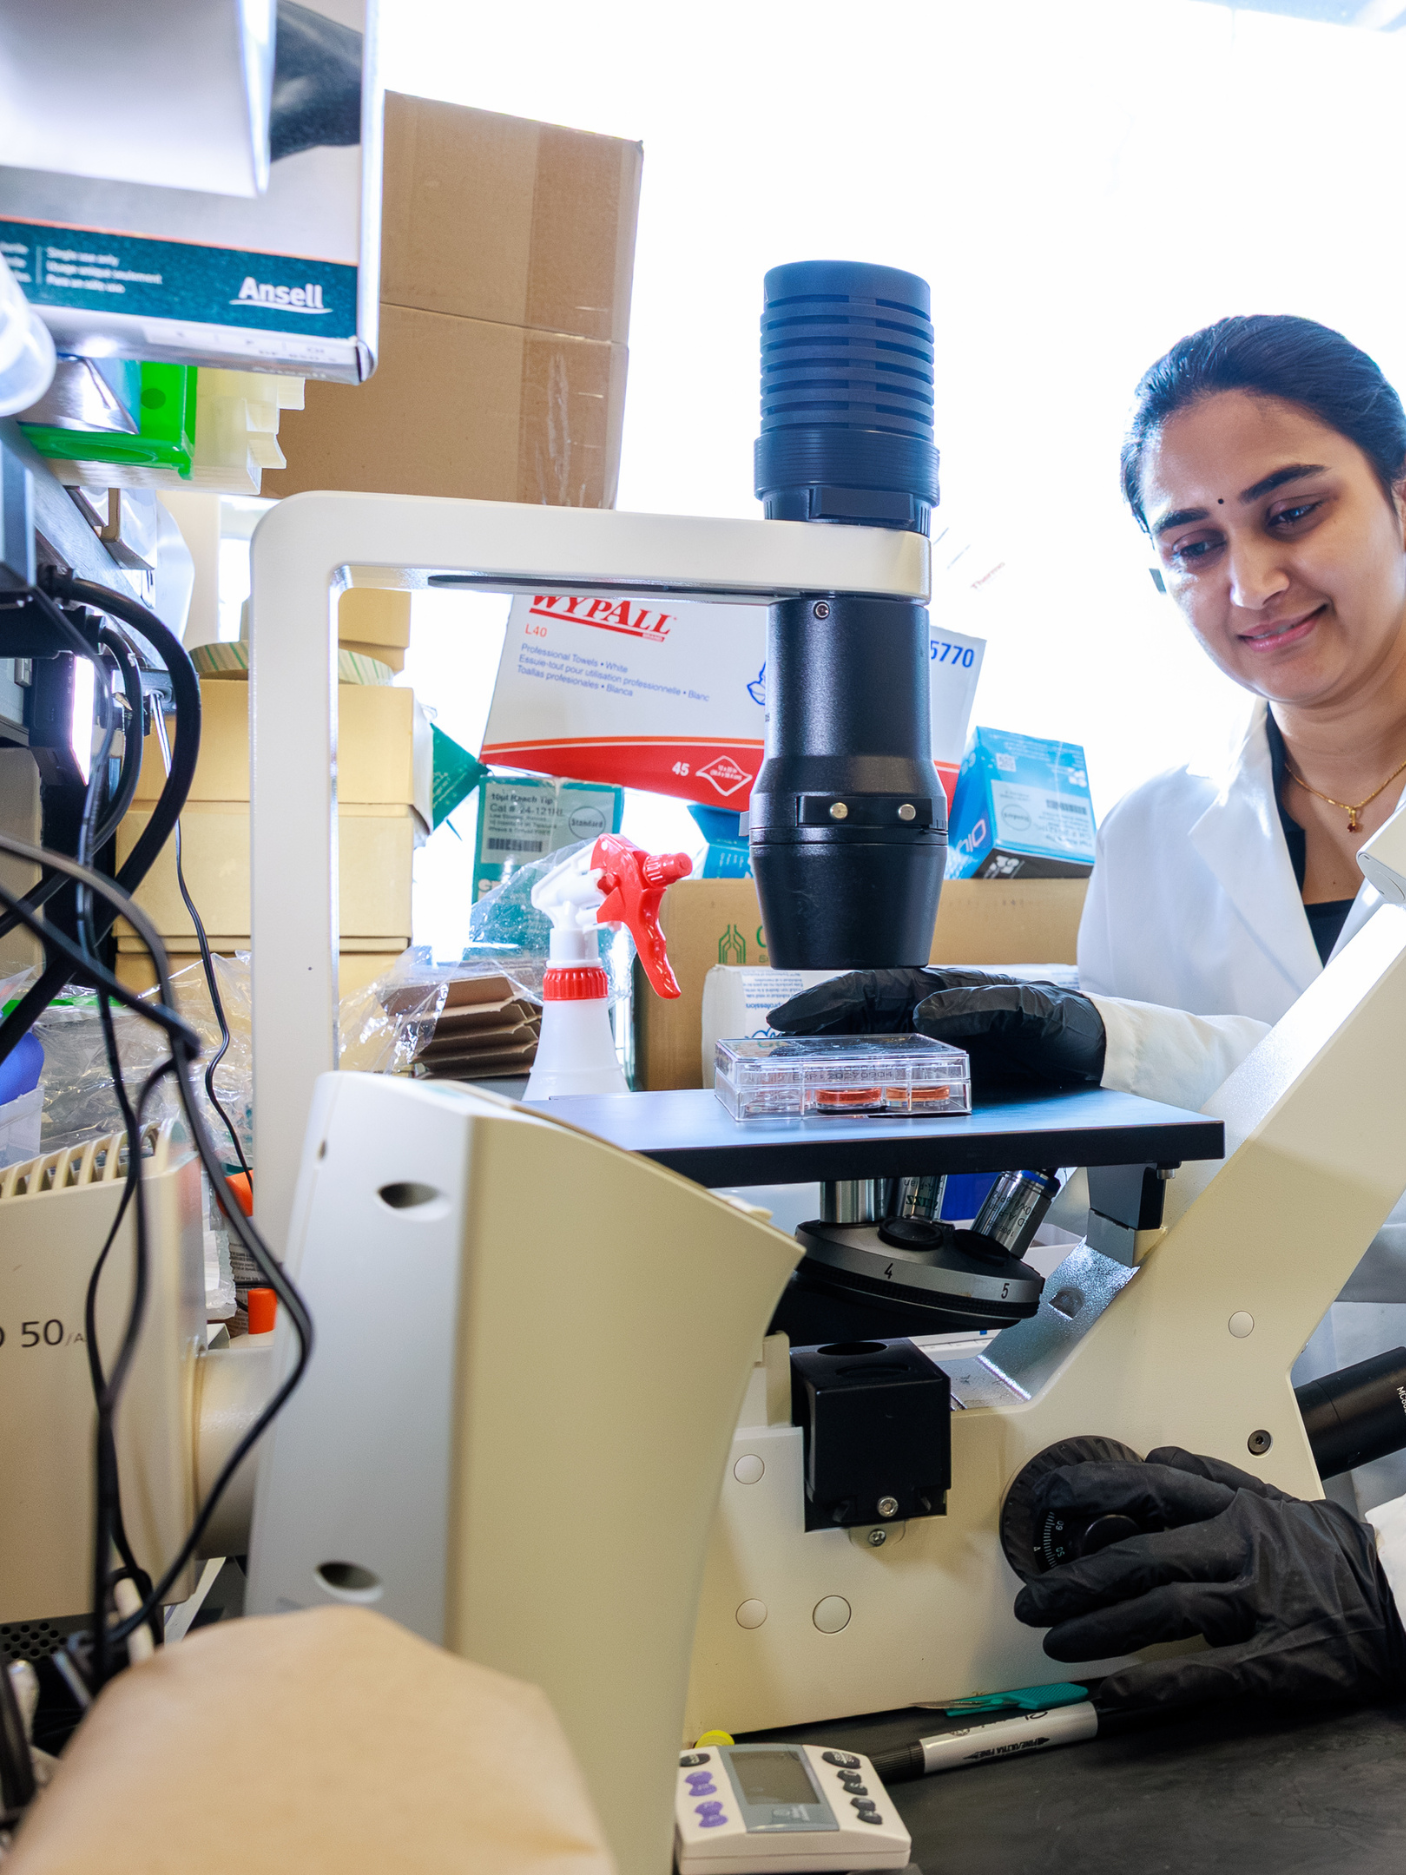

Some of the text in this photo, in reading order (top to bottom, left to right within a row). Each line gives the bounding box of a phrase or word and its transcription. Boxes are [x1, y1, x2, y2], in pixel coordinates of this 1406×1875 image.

[238, 276, 324, 309] Ansell
[970, 562, 1005, 590] Thermo
[525, 624, 547, 638] L40
[521, 643, 628, 673] Professional Towels White
[517, 665, 633, 697] Toallas profesionales Blanca
[519, 654, 709, 702] Essuie-tout pour utilisation professionnelle Blanc
[672, 761, 691, 776] 45
[490, 803, 507, 812] Cat
[571, 818, 603, 828] Standard
[884, 1263, 893, 1279] 4
[1001, 1283, 1010, 1299] 5
[1055, 1520, 1065, 1531] 60
[1055, 1546, 1066, 1558] 50
